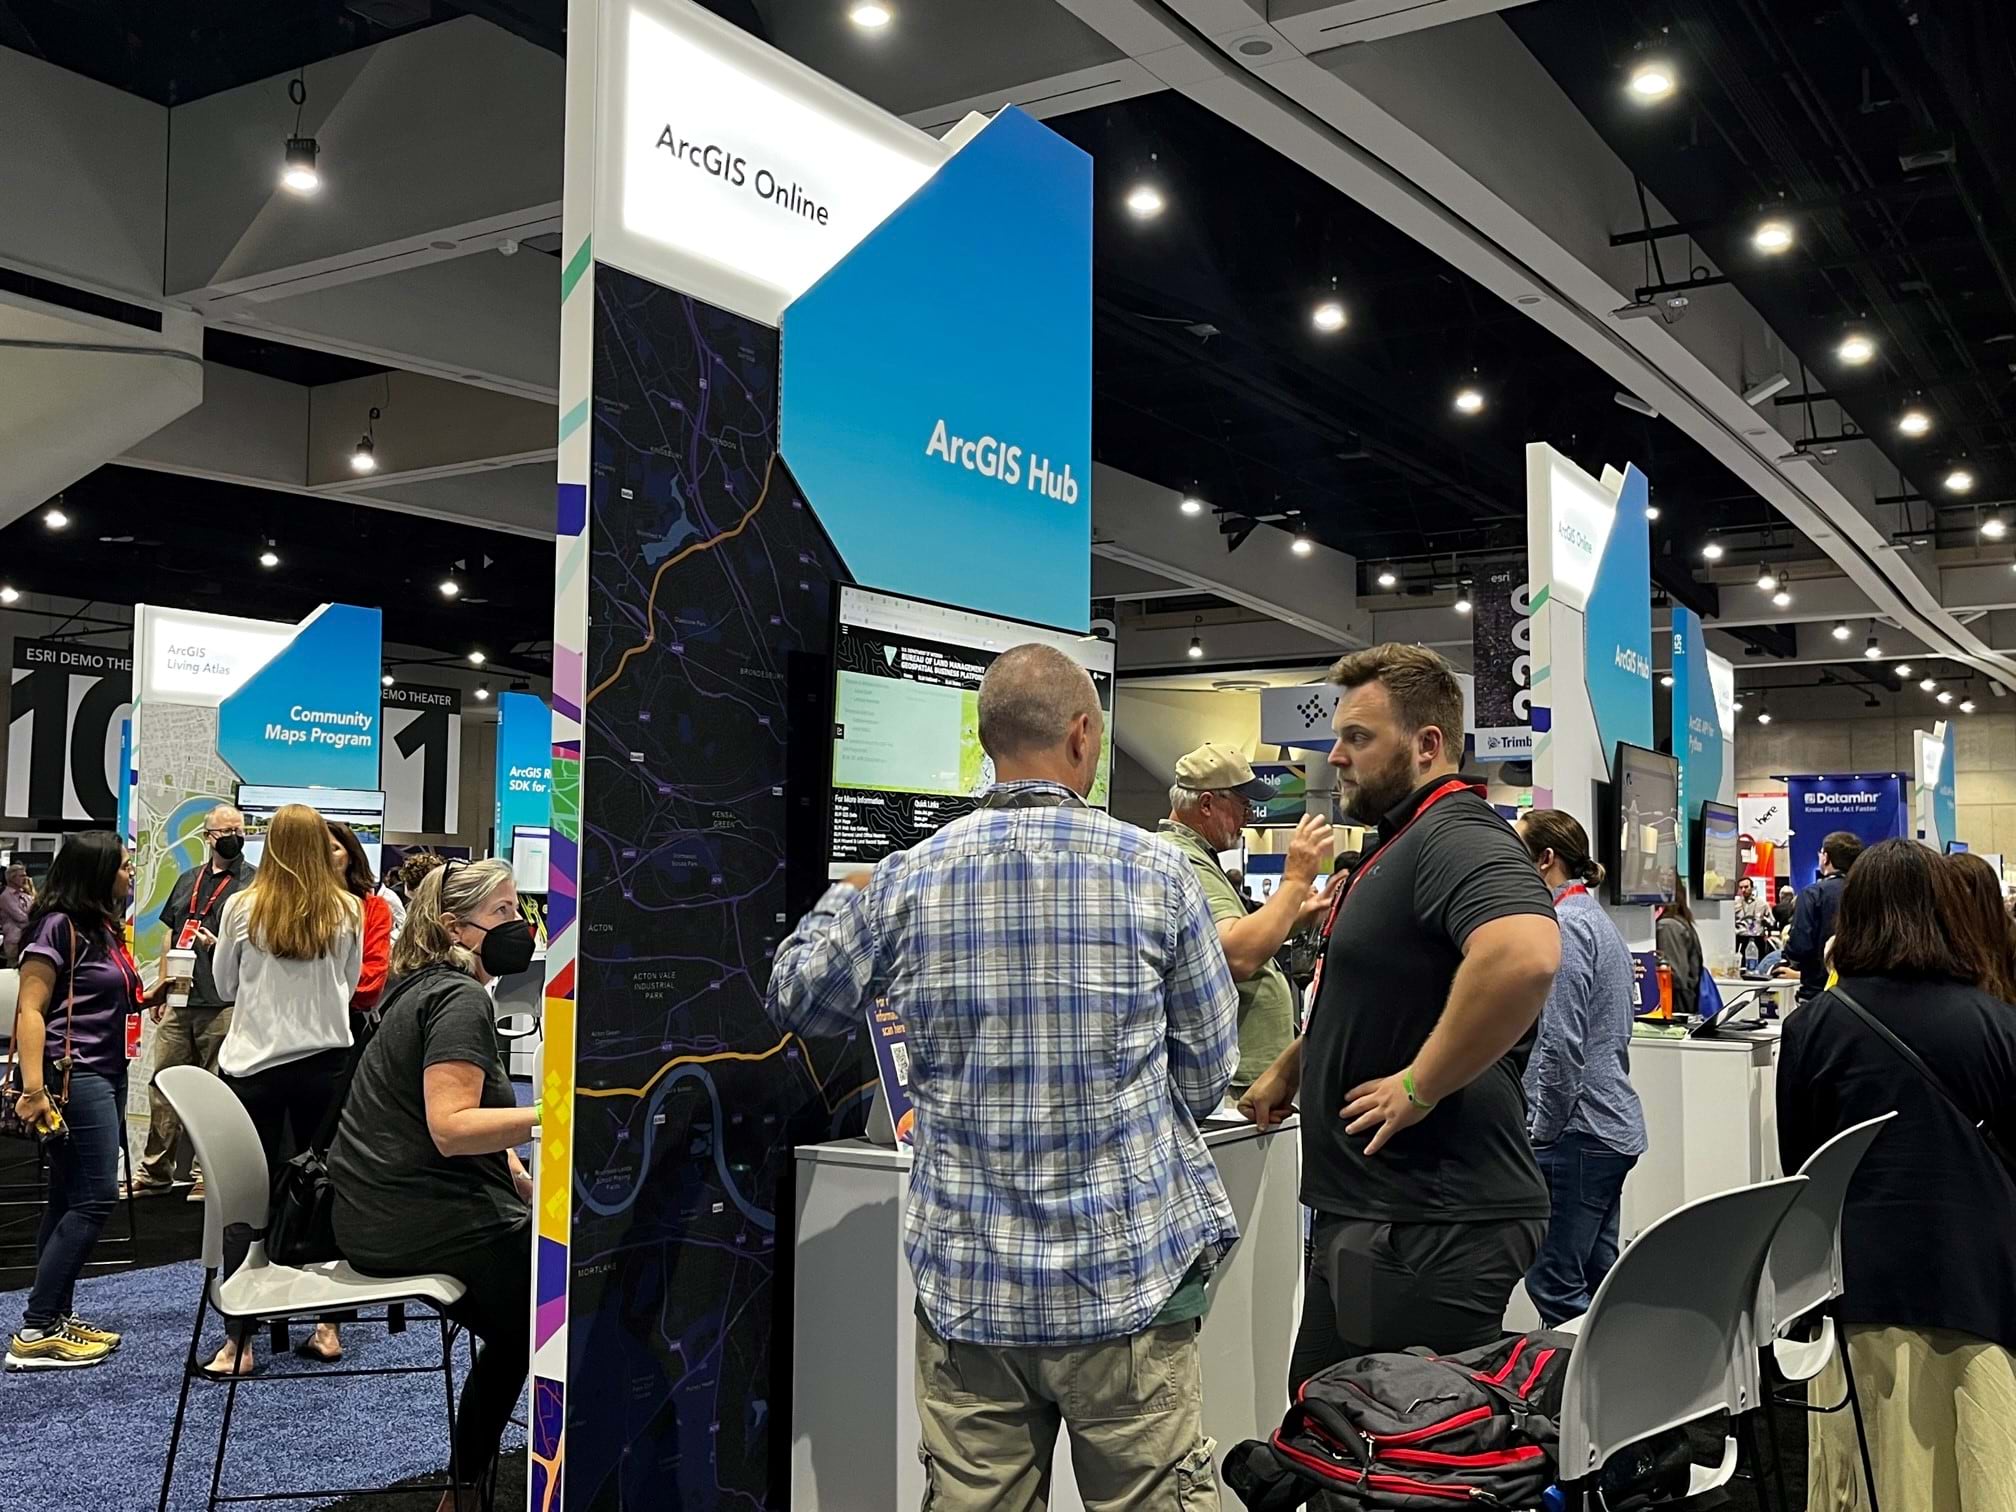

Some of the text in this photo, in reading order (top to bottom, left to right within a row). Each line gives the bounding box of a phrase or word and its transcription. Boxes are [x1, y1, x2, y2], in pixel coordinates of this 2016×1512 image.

[655, 123, 829, 226] ArcGIS Online
[925, 419, 1078, 505] ArcGIS Hub
[1491, 572, 1510, 583] esri
[168, 644, 206, 658] ArcGIS
[1674, 634, 1685, 655] esri
[26, 648, 132, 671] ESRI DEMO THE
[167, 659, 230, 676] Living Atlas
[1615, 644, 1649, 680] ArcGIS Hub
[380, 689, 452, 706] EMO THEATER
[290, 705, 372, 731] Community
[265, 723, 371, 748] Maps Program
[509, 766, 541, 779] ArcGIS
[509, 779, 530, 792] SDK
[532, 781, 546, 792] for
[1817, 791, 1878, 804] Dataminr
[1755, 805, 1778, 825] here
[587, 923, 614, 932] ACTON
[633, 972, 657, 981] ACTON
[644, 991, 664, 1000] PARK
